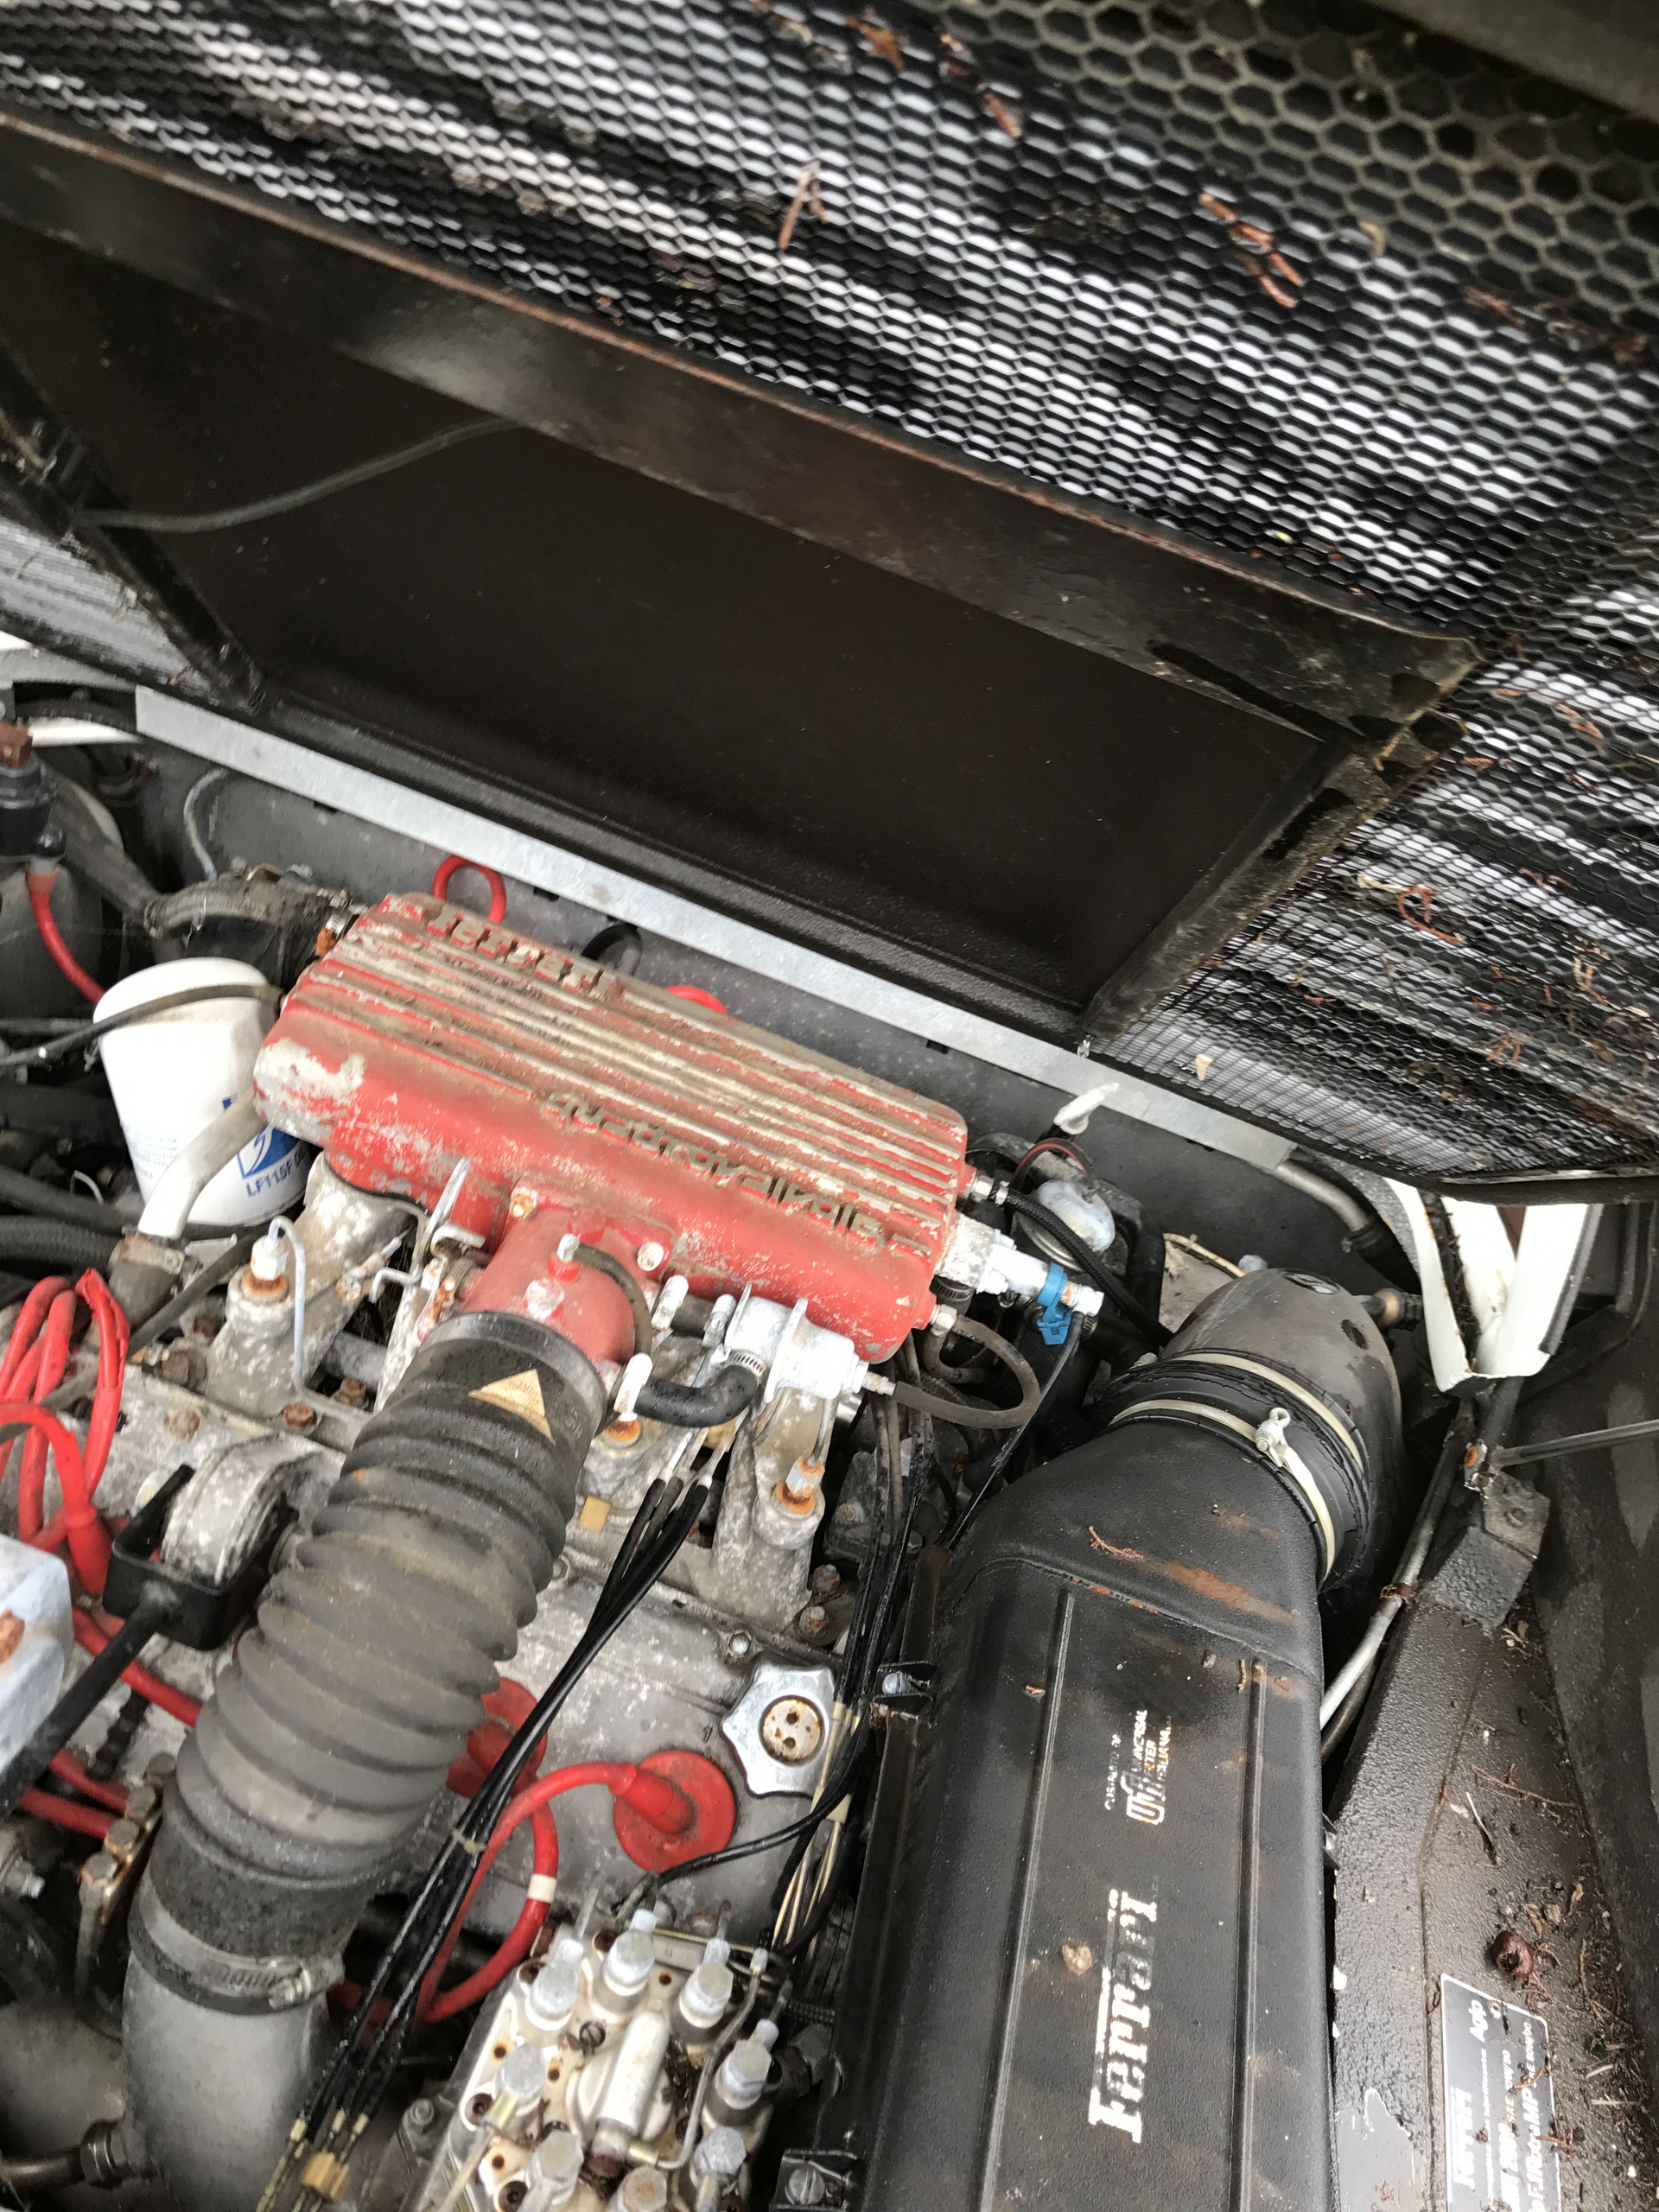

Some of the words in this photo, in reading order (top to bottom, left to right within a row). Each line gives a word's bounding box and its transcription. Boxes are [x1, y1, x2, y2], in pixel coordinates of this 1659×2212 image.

[426, 906, 617, 1001] Ferrari
[1088, 1888, 1158, 2144] Ferrari
[1469, 1999, 1488, 2043] Agip
[1451, 2085, 1475, 2190] Ferrari
